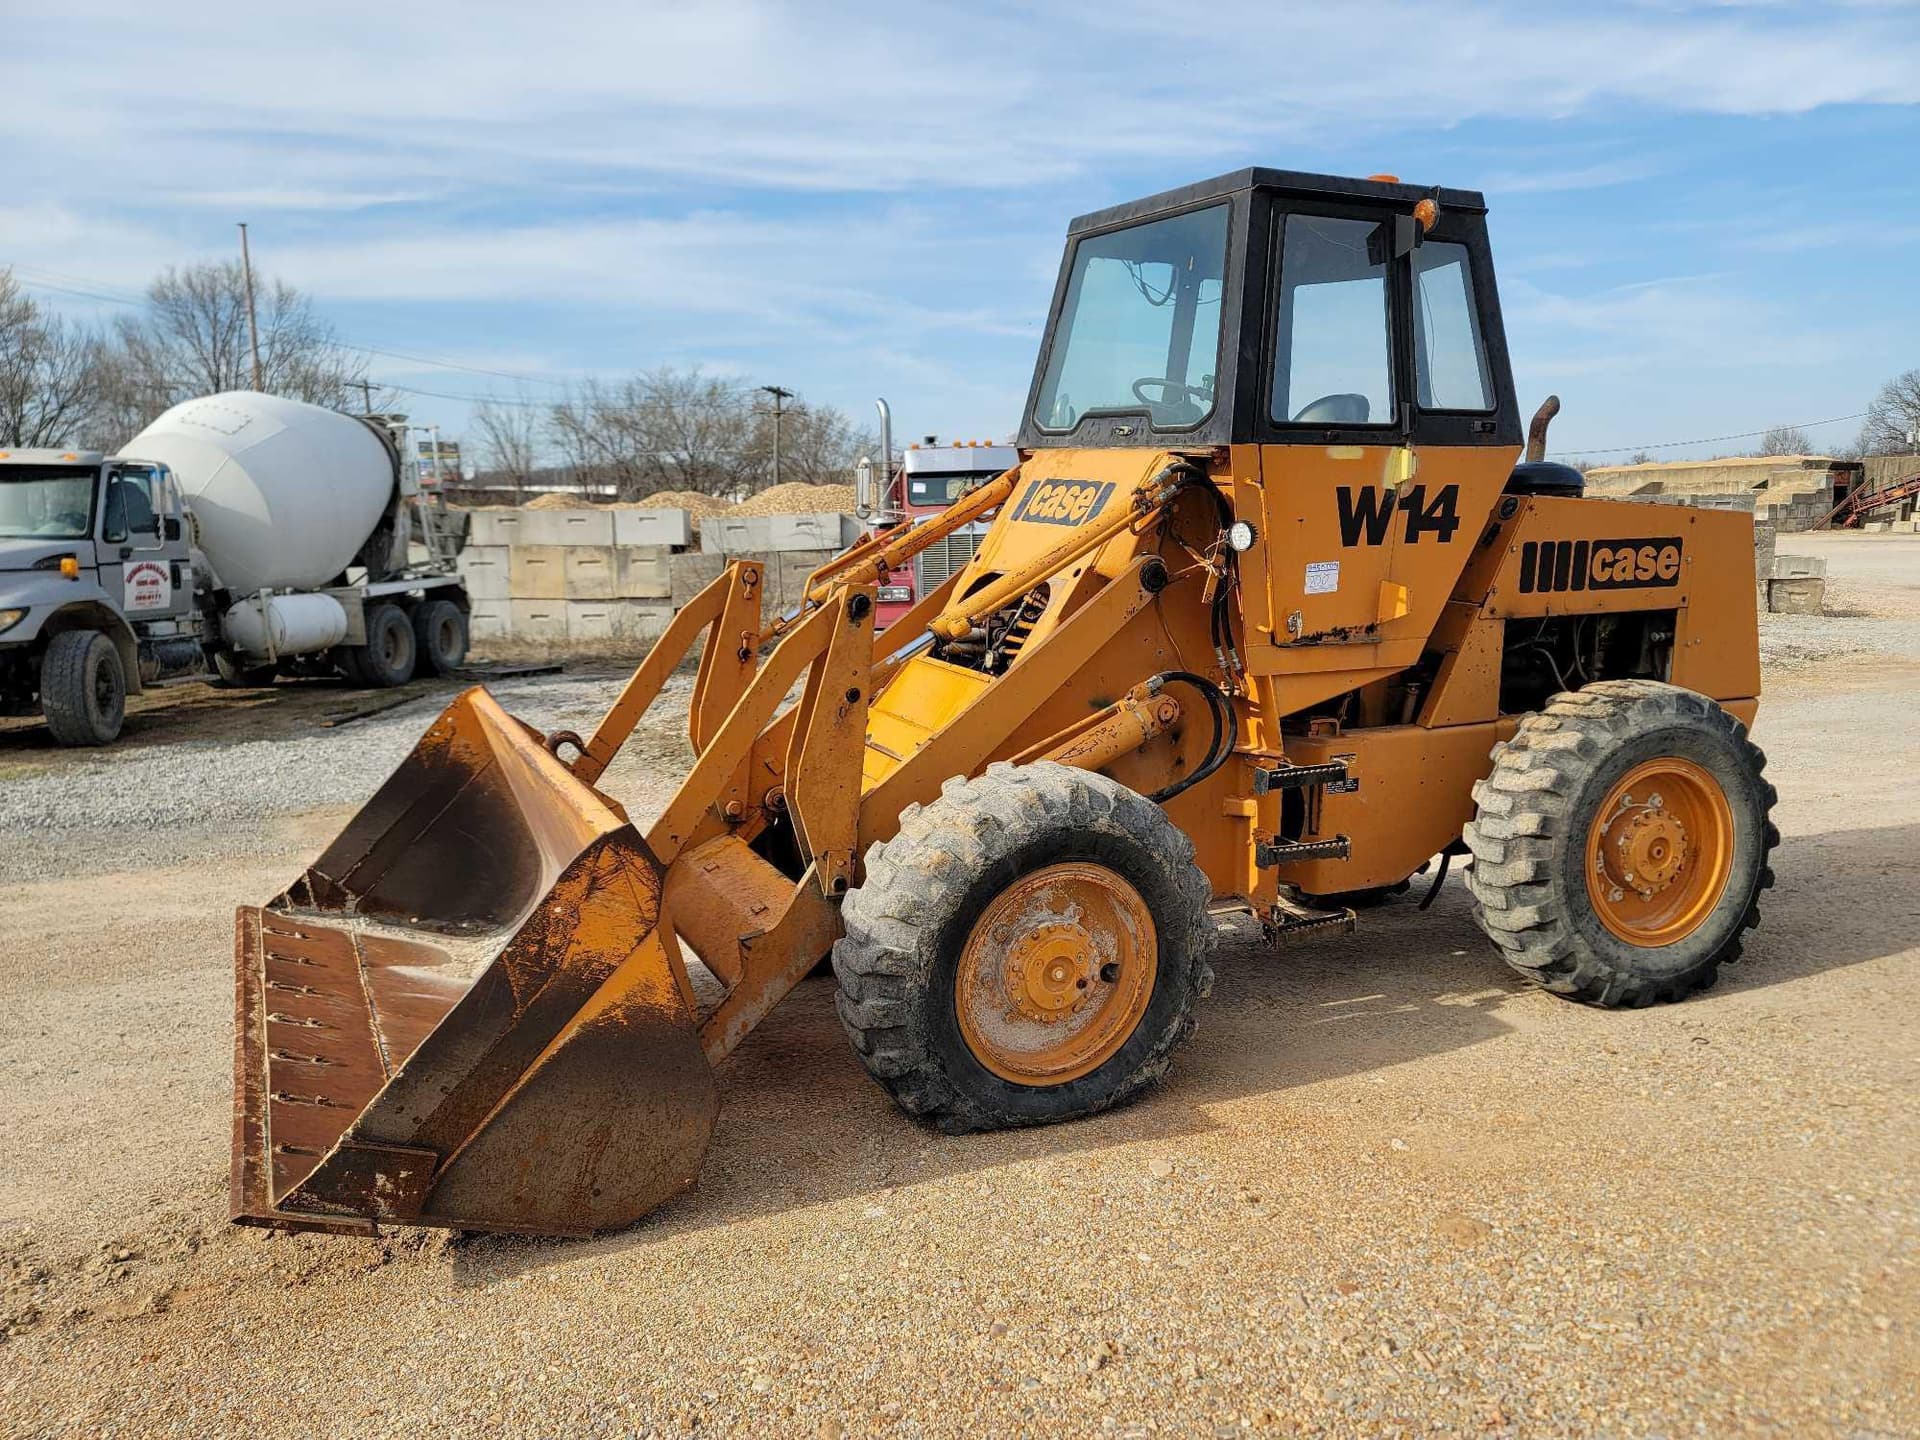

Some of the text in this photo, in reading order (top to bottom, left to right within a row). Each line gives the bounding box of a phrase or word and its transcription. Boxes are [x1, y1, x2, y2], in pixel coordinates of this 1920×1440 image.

[1028, 484, 1096, 520] case
[1336, 484, 1460, 547] W14
[1591, 545, 1680, 582] case
